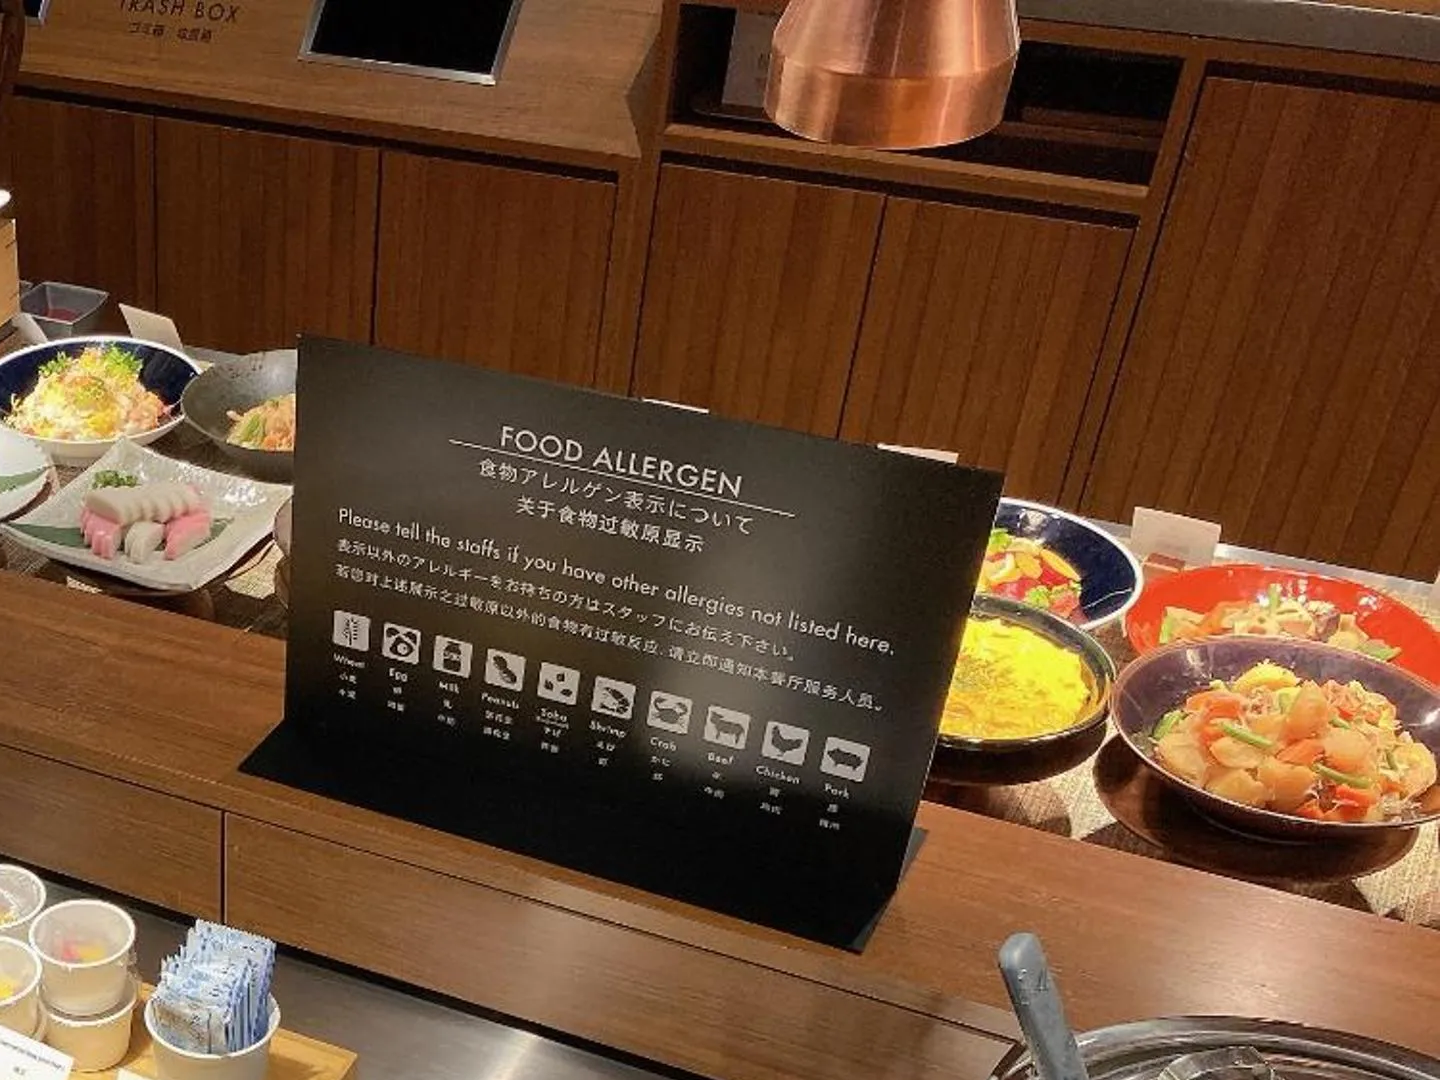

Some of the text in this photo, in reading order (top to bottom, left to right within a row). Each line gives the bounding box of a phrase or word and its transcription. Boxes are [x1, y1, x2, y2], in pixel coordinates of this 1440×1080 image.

[195, 0, 239, 22] BOX
[500, 426, 743, 498] FOOD ALLERGEN
[479, 458, 754, 535] 食物アレルゲン表示について
[516, 495, 704, 553] 关于食物过敏原显示
[339, 508, 895, 656] Please tell the staffs if you have other allergies not listed here.
[650, 736, 677, 752] Crab
[707, 752, 734, 765] Beef
[756, 765, 800, 784] Chicken
[825, 782, 850, 799] Pork
